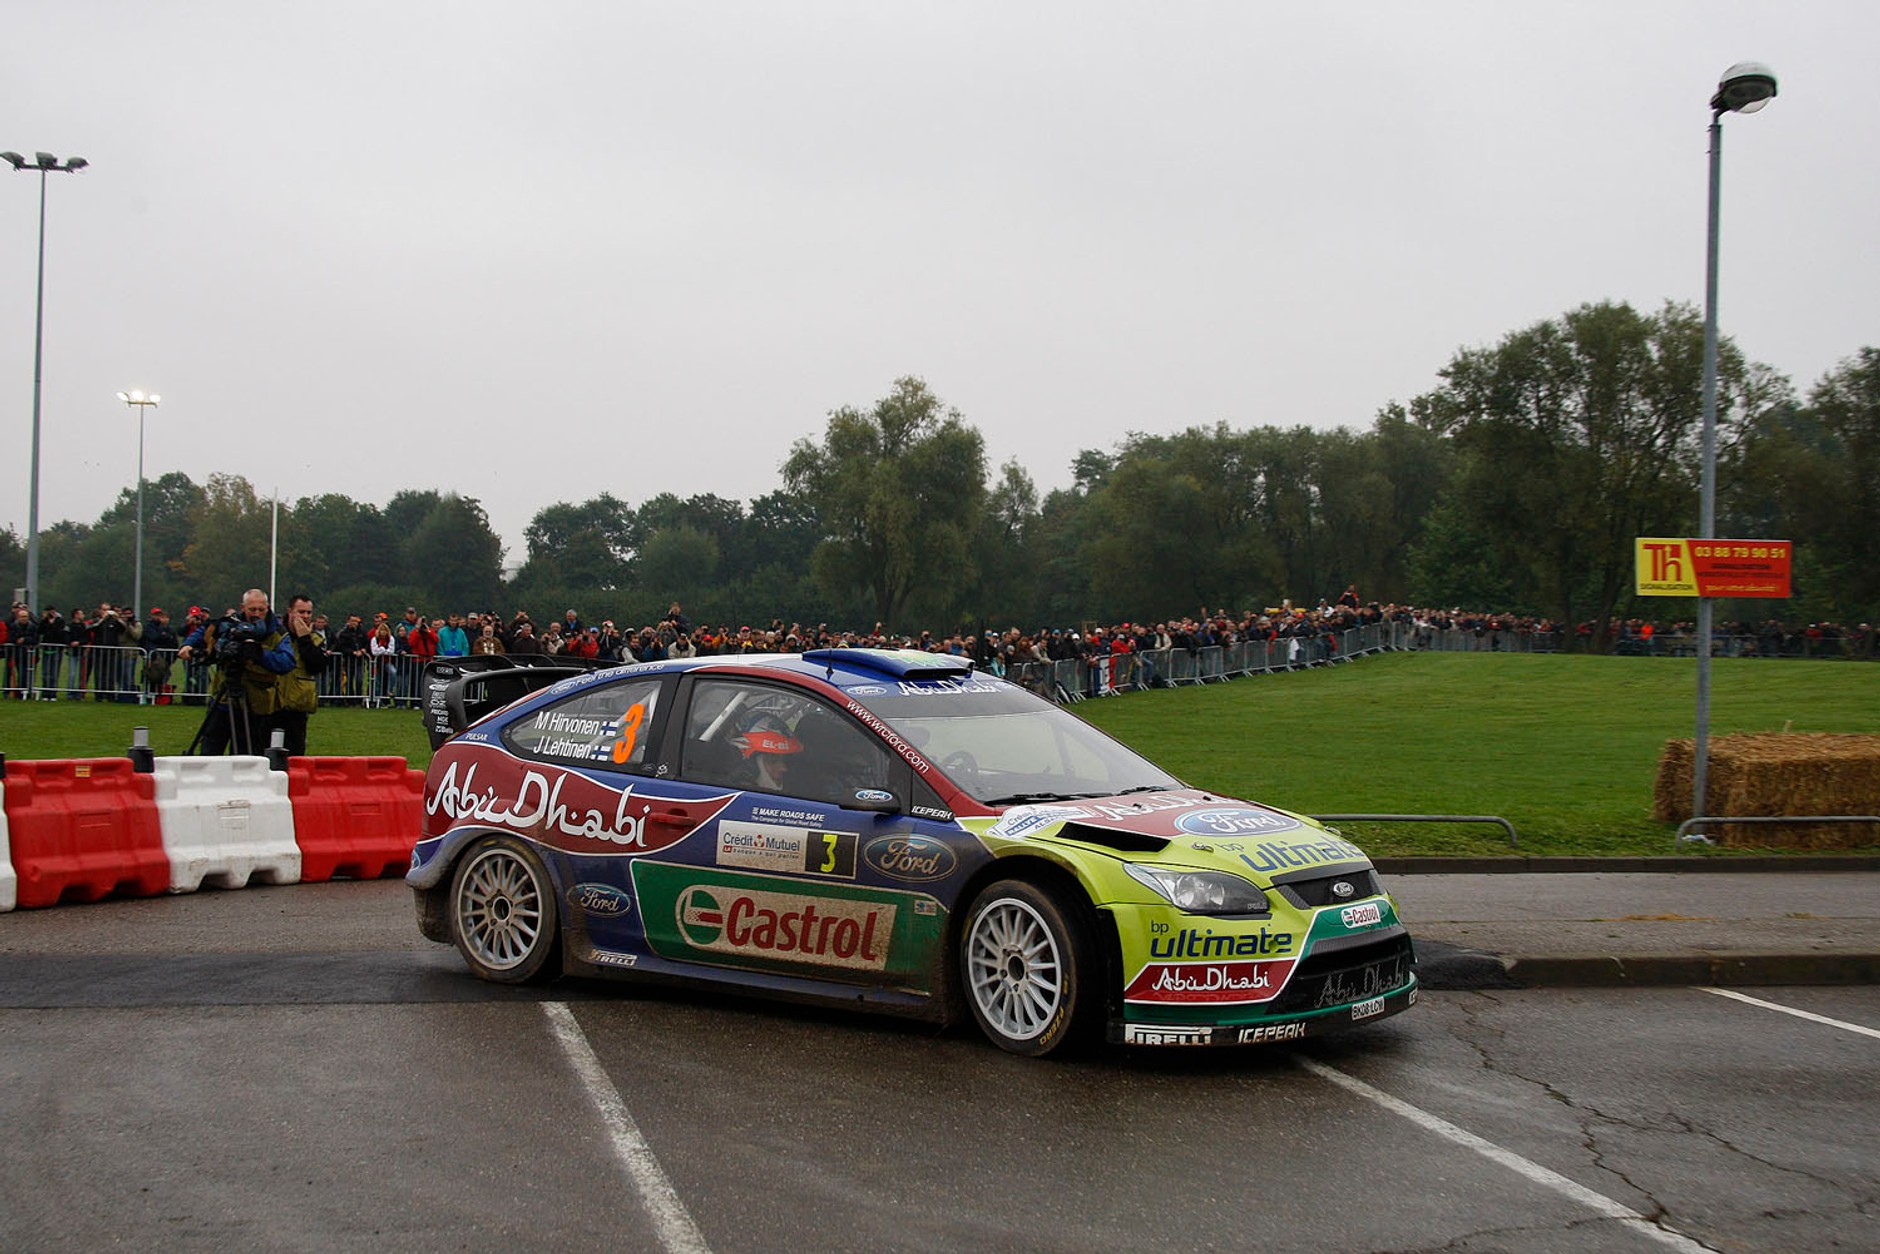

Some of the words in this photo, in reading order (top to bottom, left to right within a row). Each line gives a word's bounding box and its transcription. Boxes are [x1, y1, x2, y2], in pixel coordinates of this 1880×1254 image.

[1643, 543, 1682, 582] Th
[1695, 546, 1711, 557] 03
[1733, 547, 1749, 558] 79
[534, 711, 548, 730] M
[548, 713, 600, 736] Hirvonen
[612, 703, 645, 765] 3
[533, 736, 544, 754] J
[544, 737, 592, 760] Lehtinen
[846, 701, 930, 774] www.wrcford.com
[426, 761, 504, 822] Abu
[508, 770, 652, 848] Dhabi
[759, 808, 780, 817] MAKE
[780, 810, 805, 819] ROADS
[805, 812, 825, 822] SAFE
[911, 804, 954, 820] ICEPEAK
[1198, 812, 1286, 833] Ford
[723, 832, 754, 847] Crédit
[765, 837, 801, 852] Mutuel
[820, 833, 839, 874] 3
[1215, 843, 1244, 852] bp
[1240, 835, 1365, 872] ultimate
[880, 840, 939, 875] Ford
[580, 887, 620, 912] Ford
[1352, 904, 1380, 924] Castrol
[726, 896, 879, 962] Castrol
[1151, 920, 1169, 935] bp
[1150, 926, 1292, 958] ultimate
[590, 949, 638, 966] PIRELLI
[1152, 967, 1203, 991] Abu
[1203, 964, 1270, 991] Dhabi
[1125, 1023, 1213, 1045] PIRELLI
[1237, 1022, 1307, 1044] ICEPEAK
